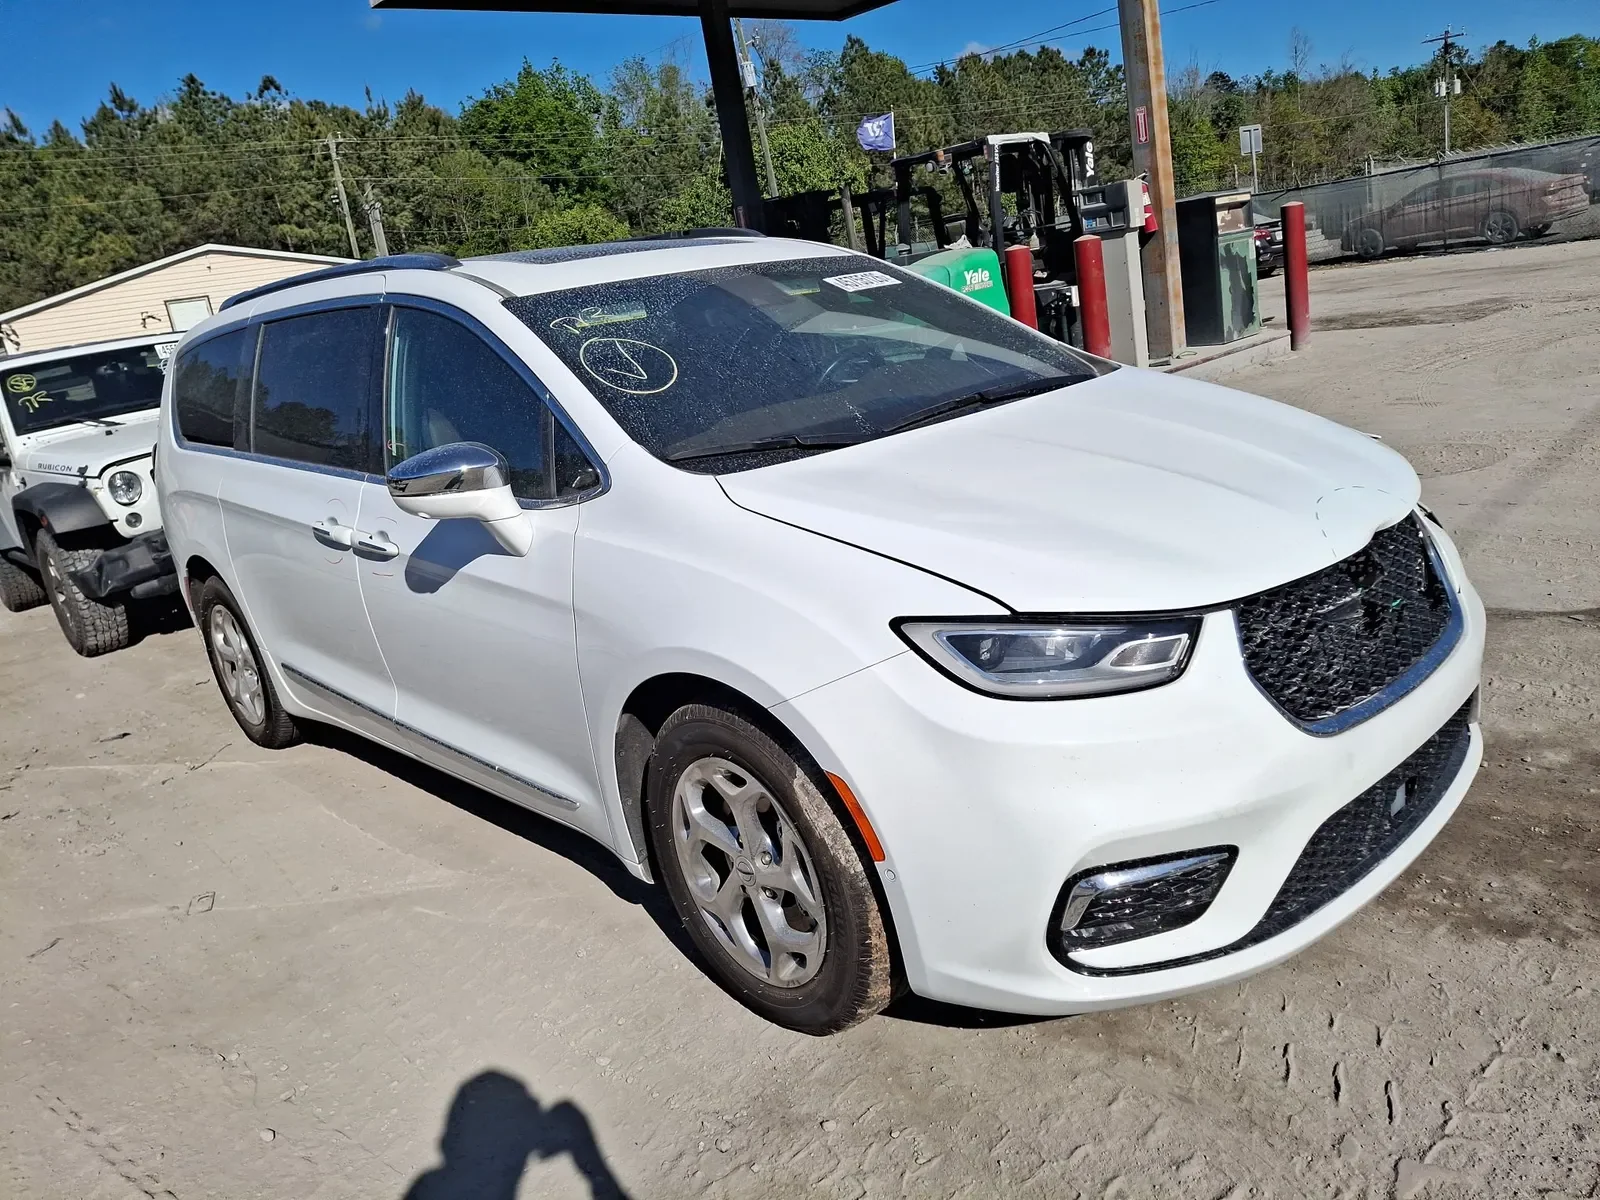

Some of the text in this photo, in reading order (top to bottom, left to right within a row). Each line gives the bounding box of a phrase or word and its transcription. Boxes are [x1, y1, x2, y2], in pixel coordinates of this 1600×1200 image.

[1084, 140, 1095, 178] Yale
[963, 267, 990, 286] Yale
[37, 462, 73, 472] RUBICON
